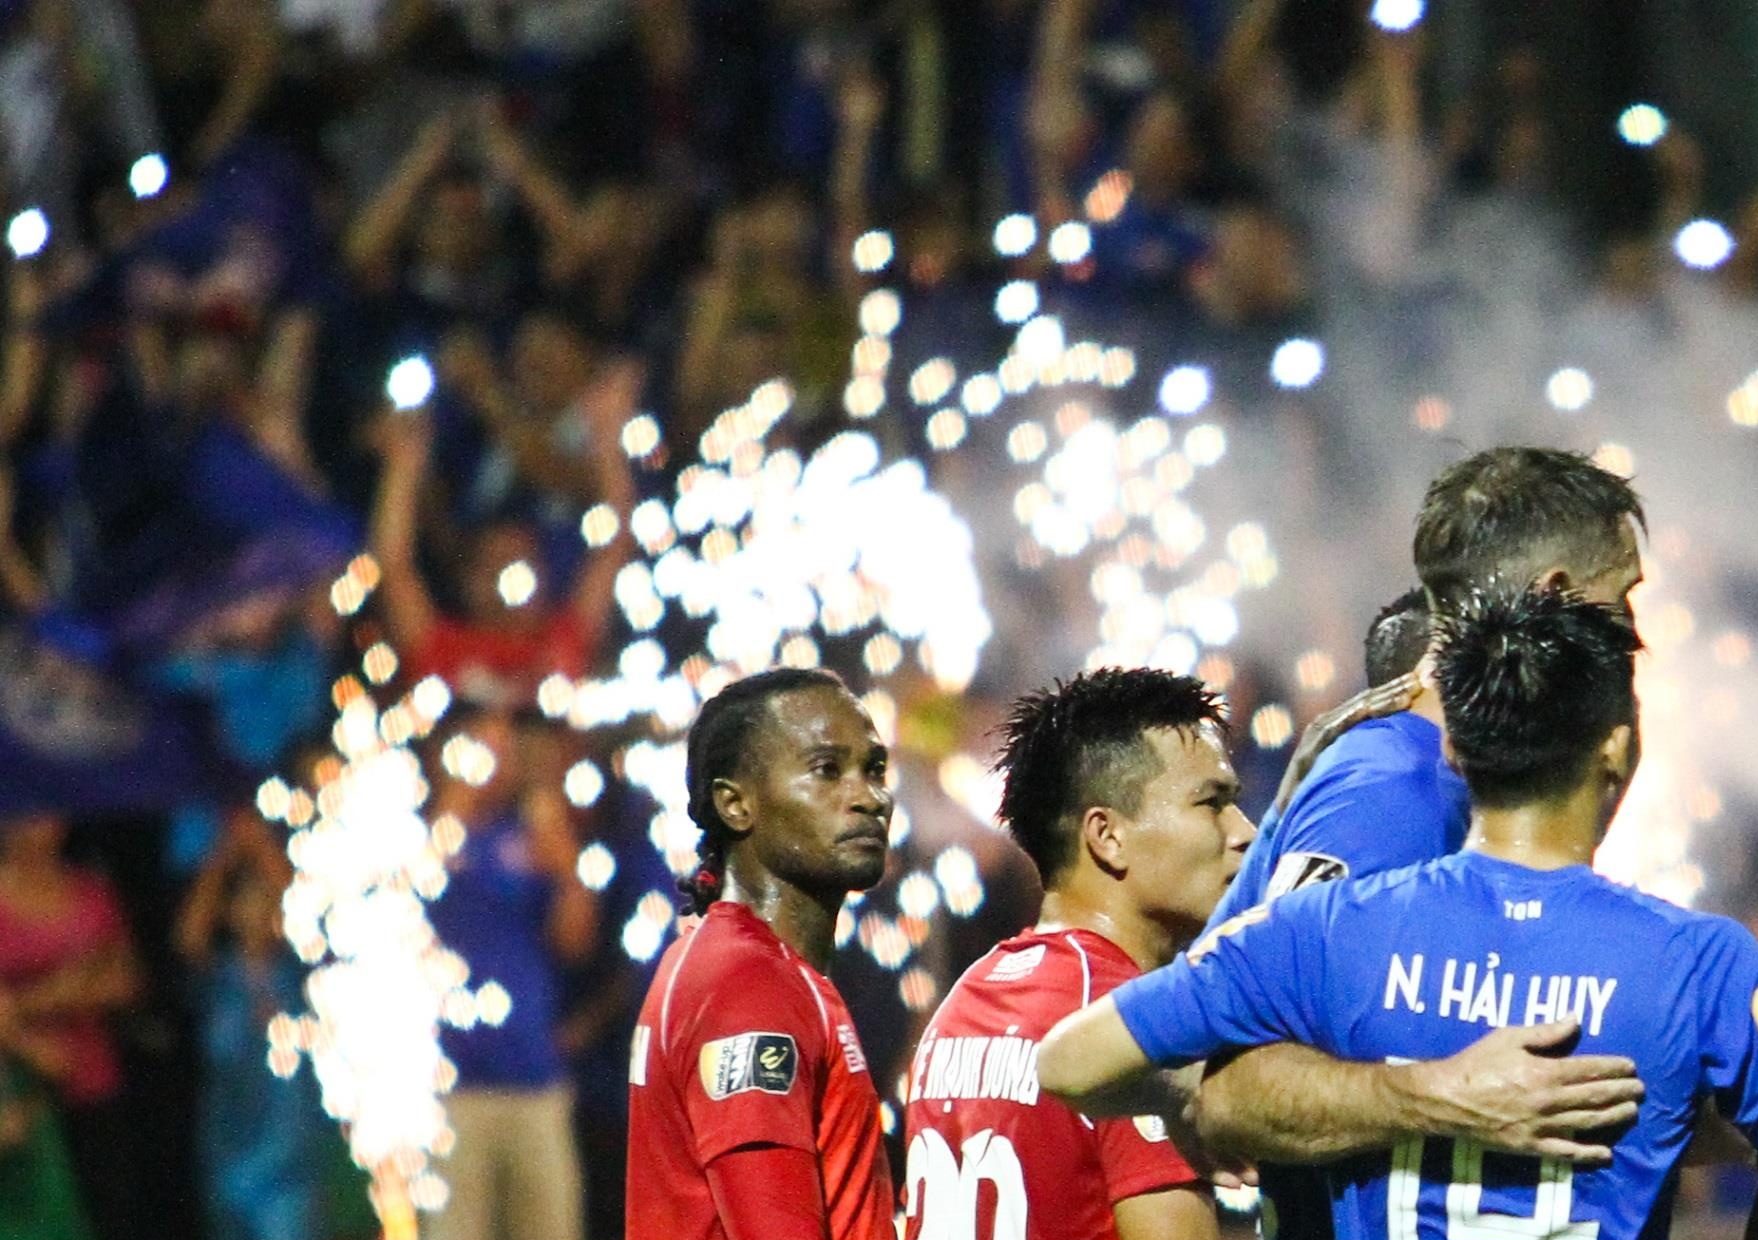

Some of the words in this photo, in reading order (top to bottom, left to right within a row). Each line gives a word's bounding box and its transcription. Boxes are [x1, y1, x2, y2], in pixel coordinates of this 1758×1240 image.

[1384, 953, 1425, 1014] N.
[1439, 952, 1514, 1028] HẢI
[1525, 975, 1618, 1036] HUY
